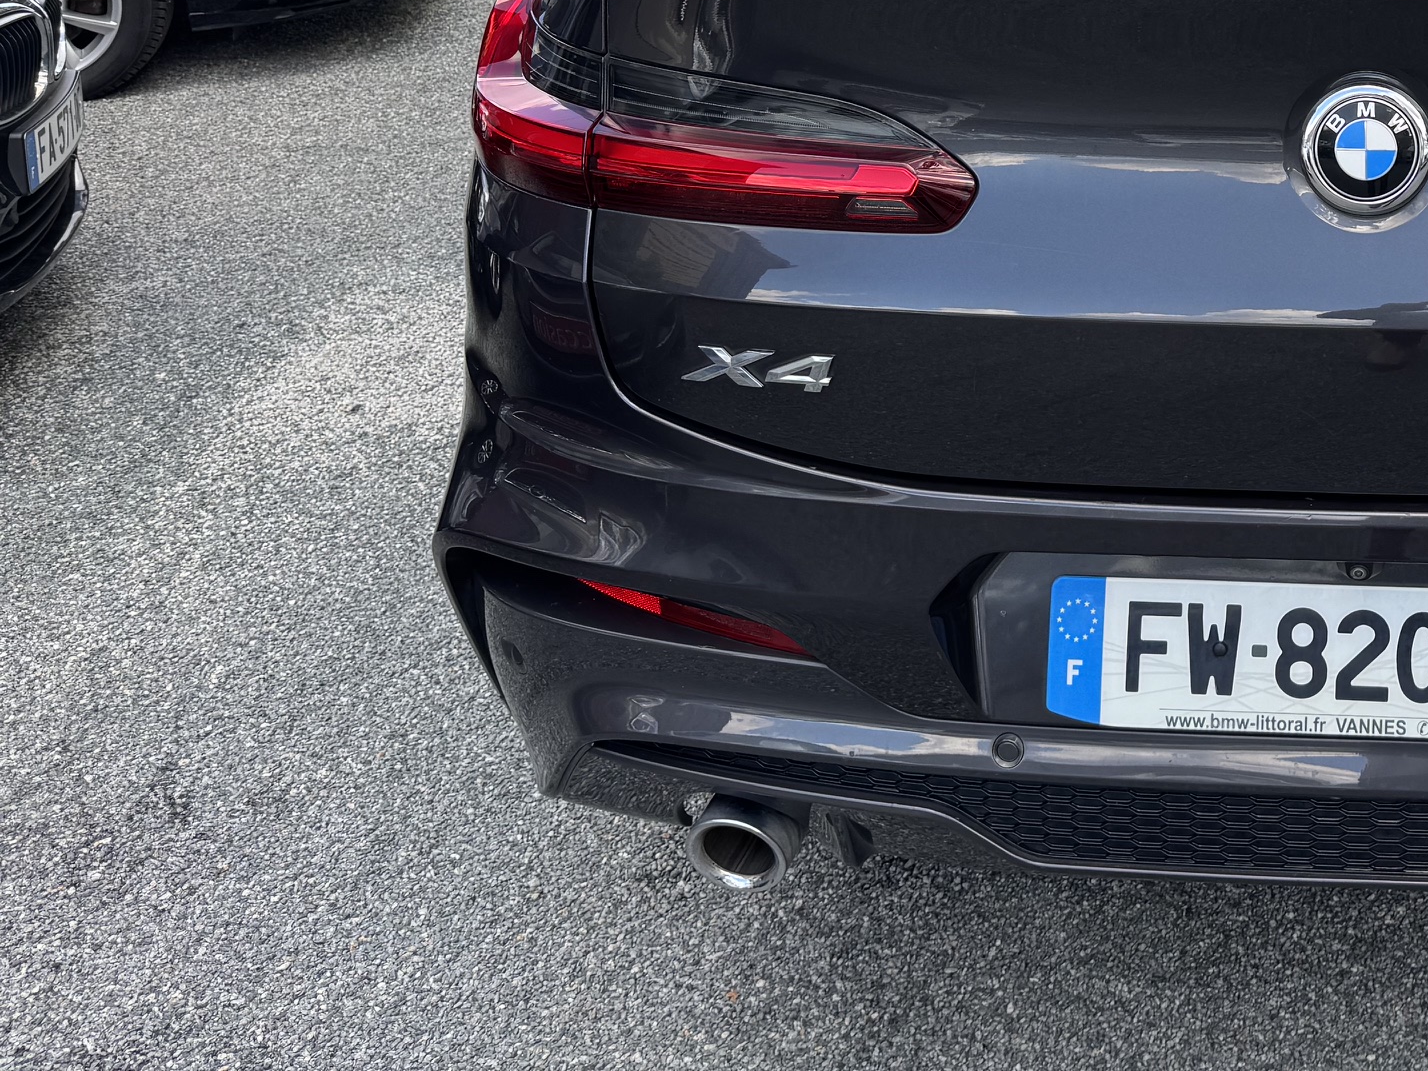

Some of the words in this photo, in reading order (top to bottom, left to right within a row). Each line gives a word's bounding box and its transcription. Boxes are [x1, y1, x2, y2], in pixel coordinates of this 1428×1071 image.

[1326, 102, 1409, 134] BMW
[681, 345, 836, 392] X4
[1066, 659, 1083, 686] F
[1165, 712, 1327, 733] www.bmw-littoral.fr
[1335, 717, 1407, 736] VANNES
